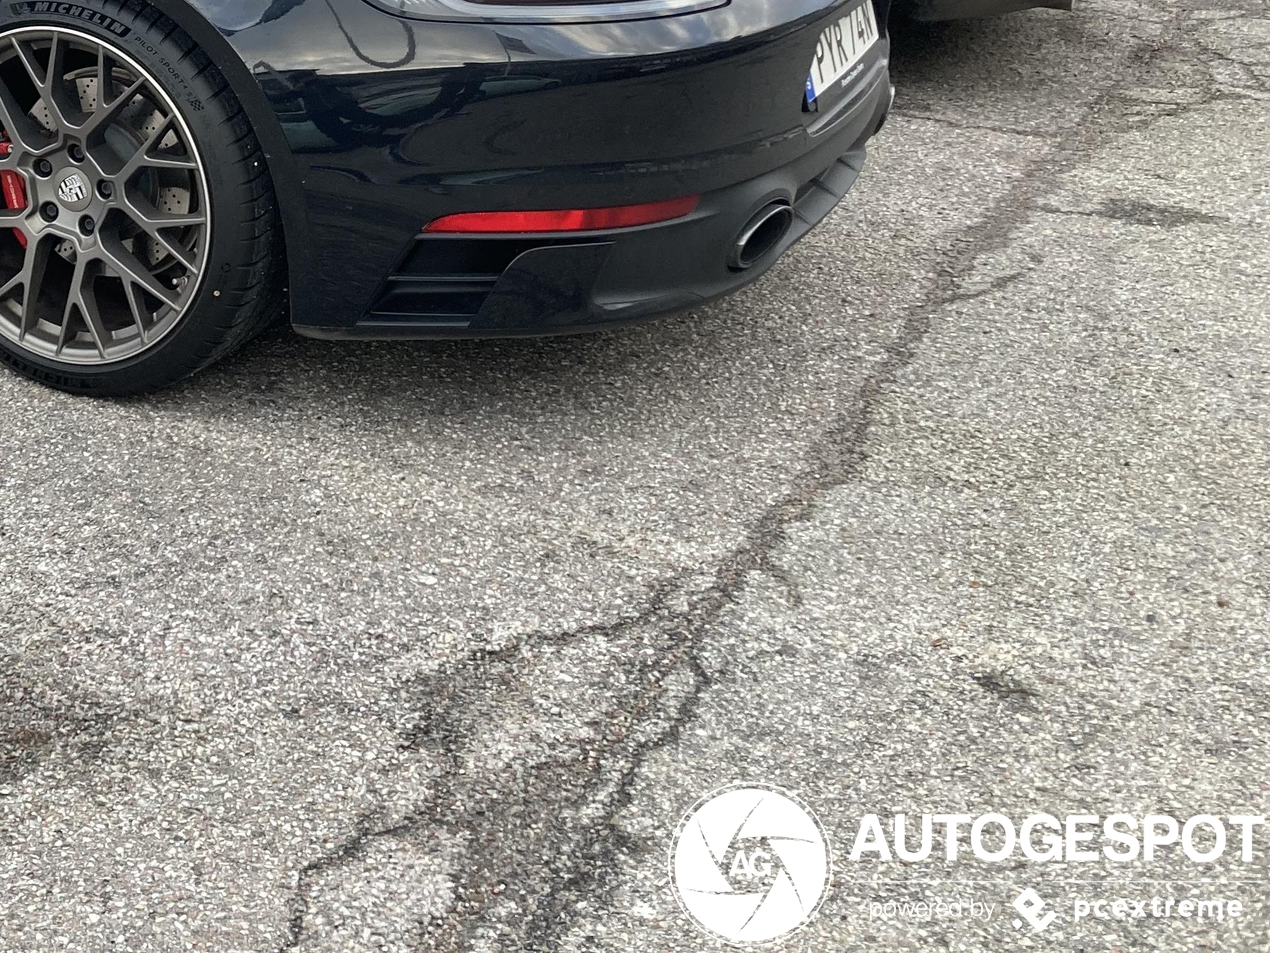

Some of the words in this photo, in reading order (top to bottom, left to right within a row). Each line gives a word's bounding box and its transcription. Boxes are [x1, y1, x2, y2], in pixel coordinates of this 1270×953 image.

[34, 1, 126, 35] MICHELIN
[134, 36, 158, 56] PILOT
[158, 57, 185, 85] SPORT
[815, 22, 849, 85] PYR
